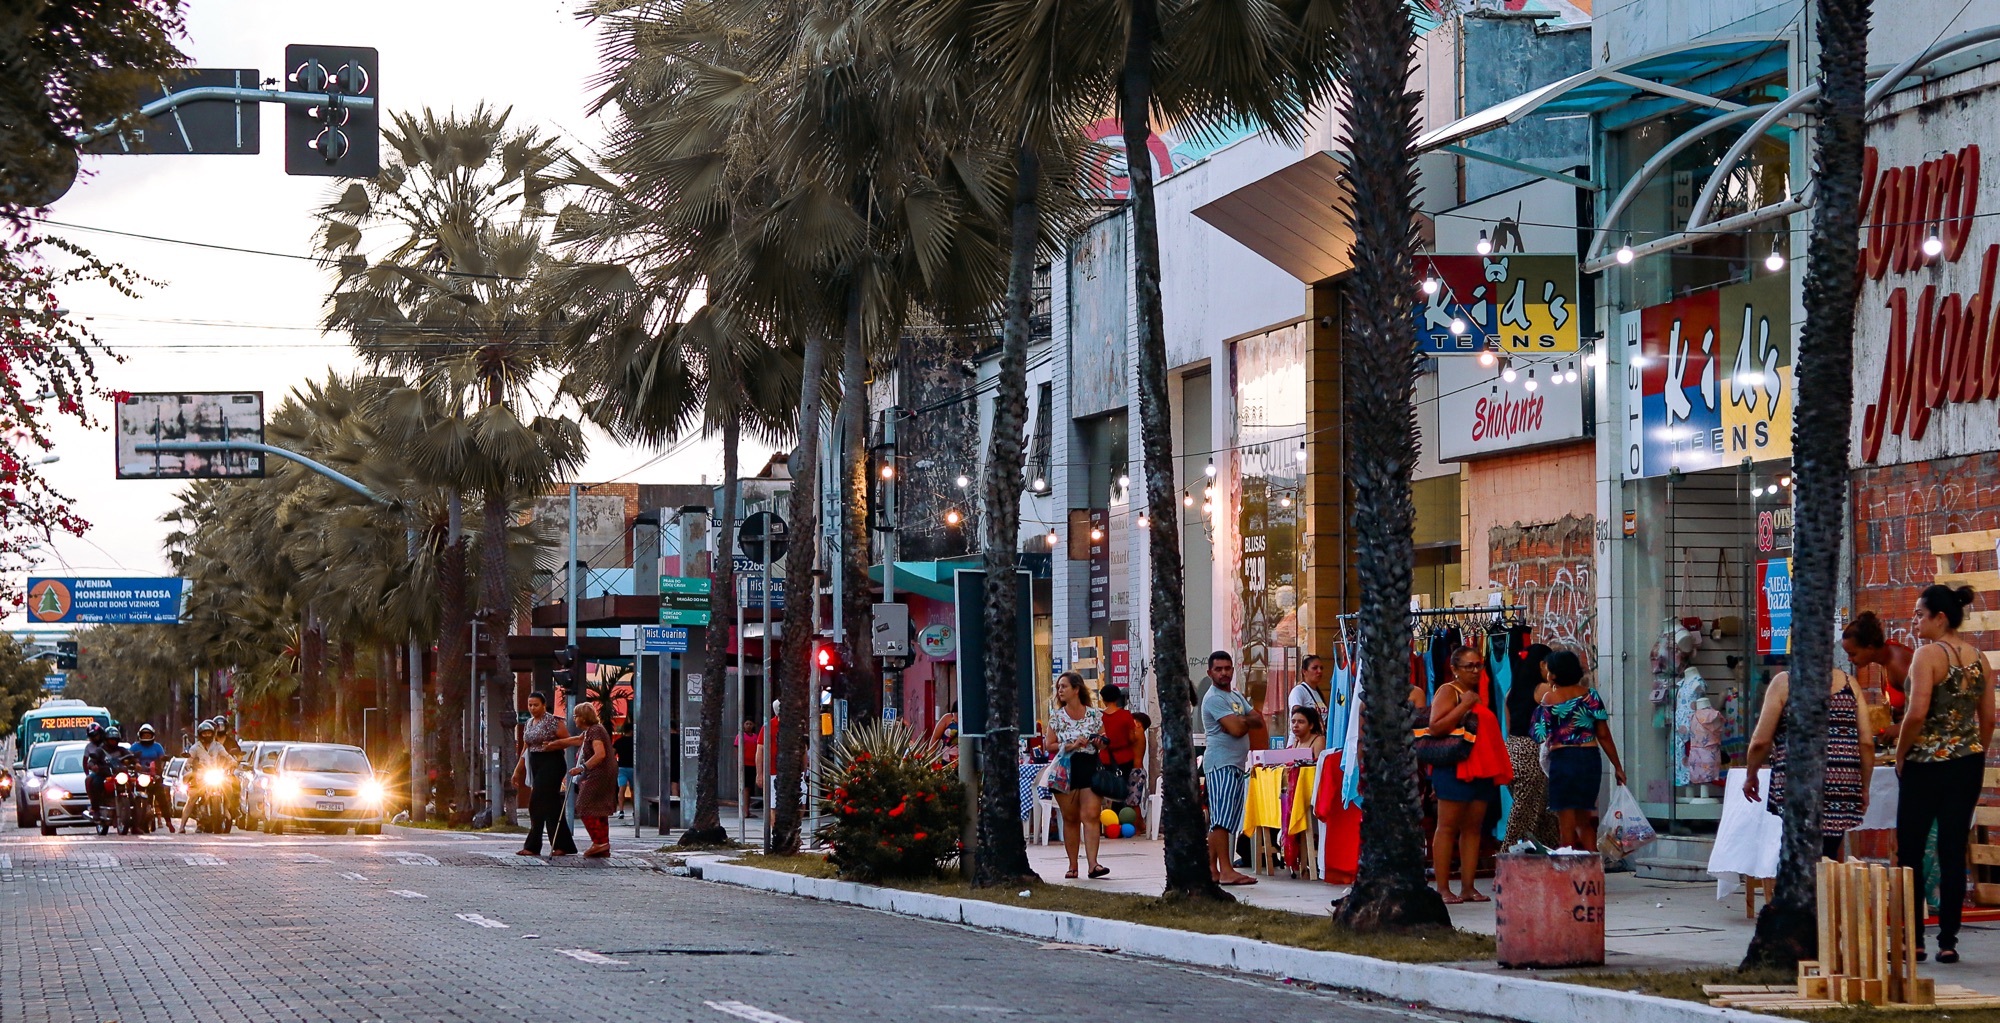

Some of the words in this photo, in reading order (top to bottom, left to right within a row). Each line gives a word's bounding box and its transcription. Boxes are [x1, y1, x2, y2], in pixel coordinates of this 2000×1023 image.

[1430, 334, 1556, 349] TEENS
[1627, 321, 1640, 475] OTSE
[1472, 389, 1544, 442] Shokante
[1671, 420, 1770, 454] TEENS
[1244, 535, 1266, 553] BLUSAS
[75, 580, 112, 588] AVENIDA
[1768, 576, 1792, 592] MEGA
[75, 590, 132, 599] MONSENHOR
[134, 590, 171, 598] TABOSA
[129, 600, 160, 608] VIZINHOS
[646, 628, 660, 638] Hist.
[662, 629, 686, 639] Guarino
[1760, 627, 1770, 641] Loja
[41, 718, 56, 728] 752
[33, 733, 51, 742] 752
